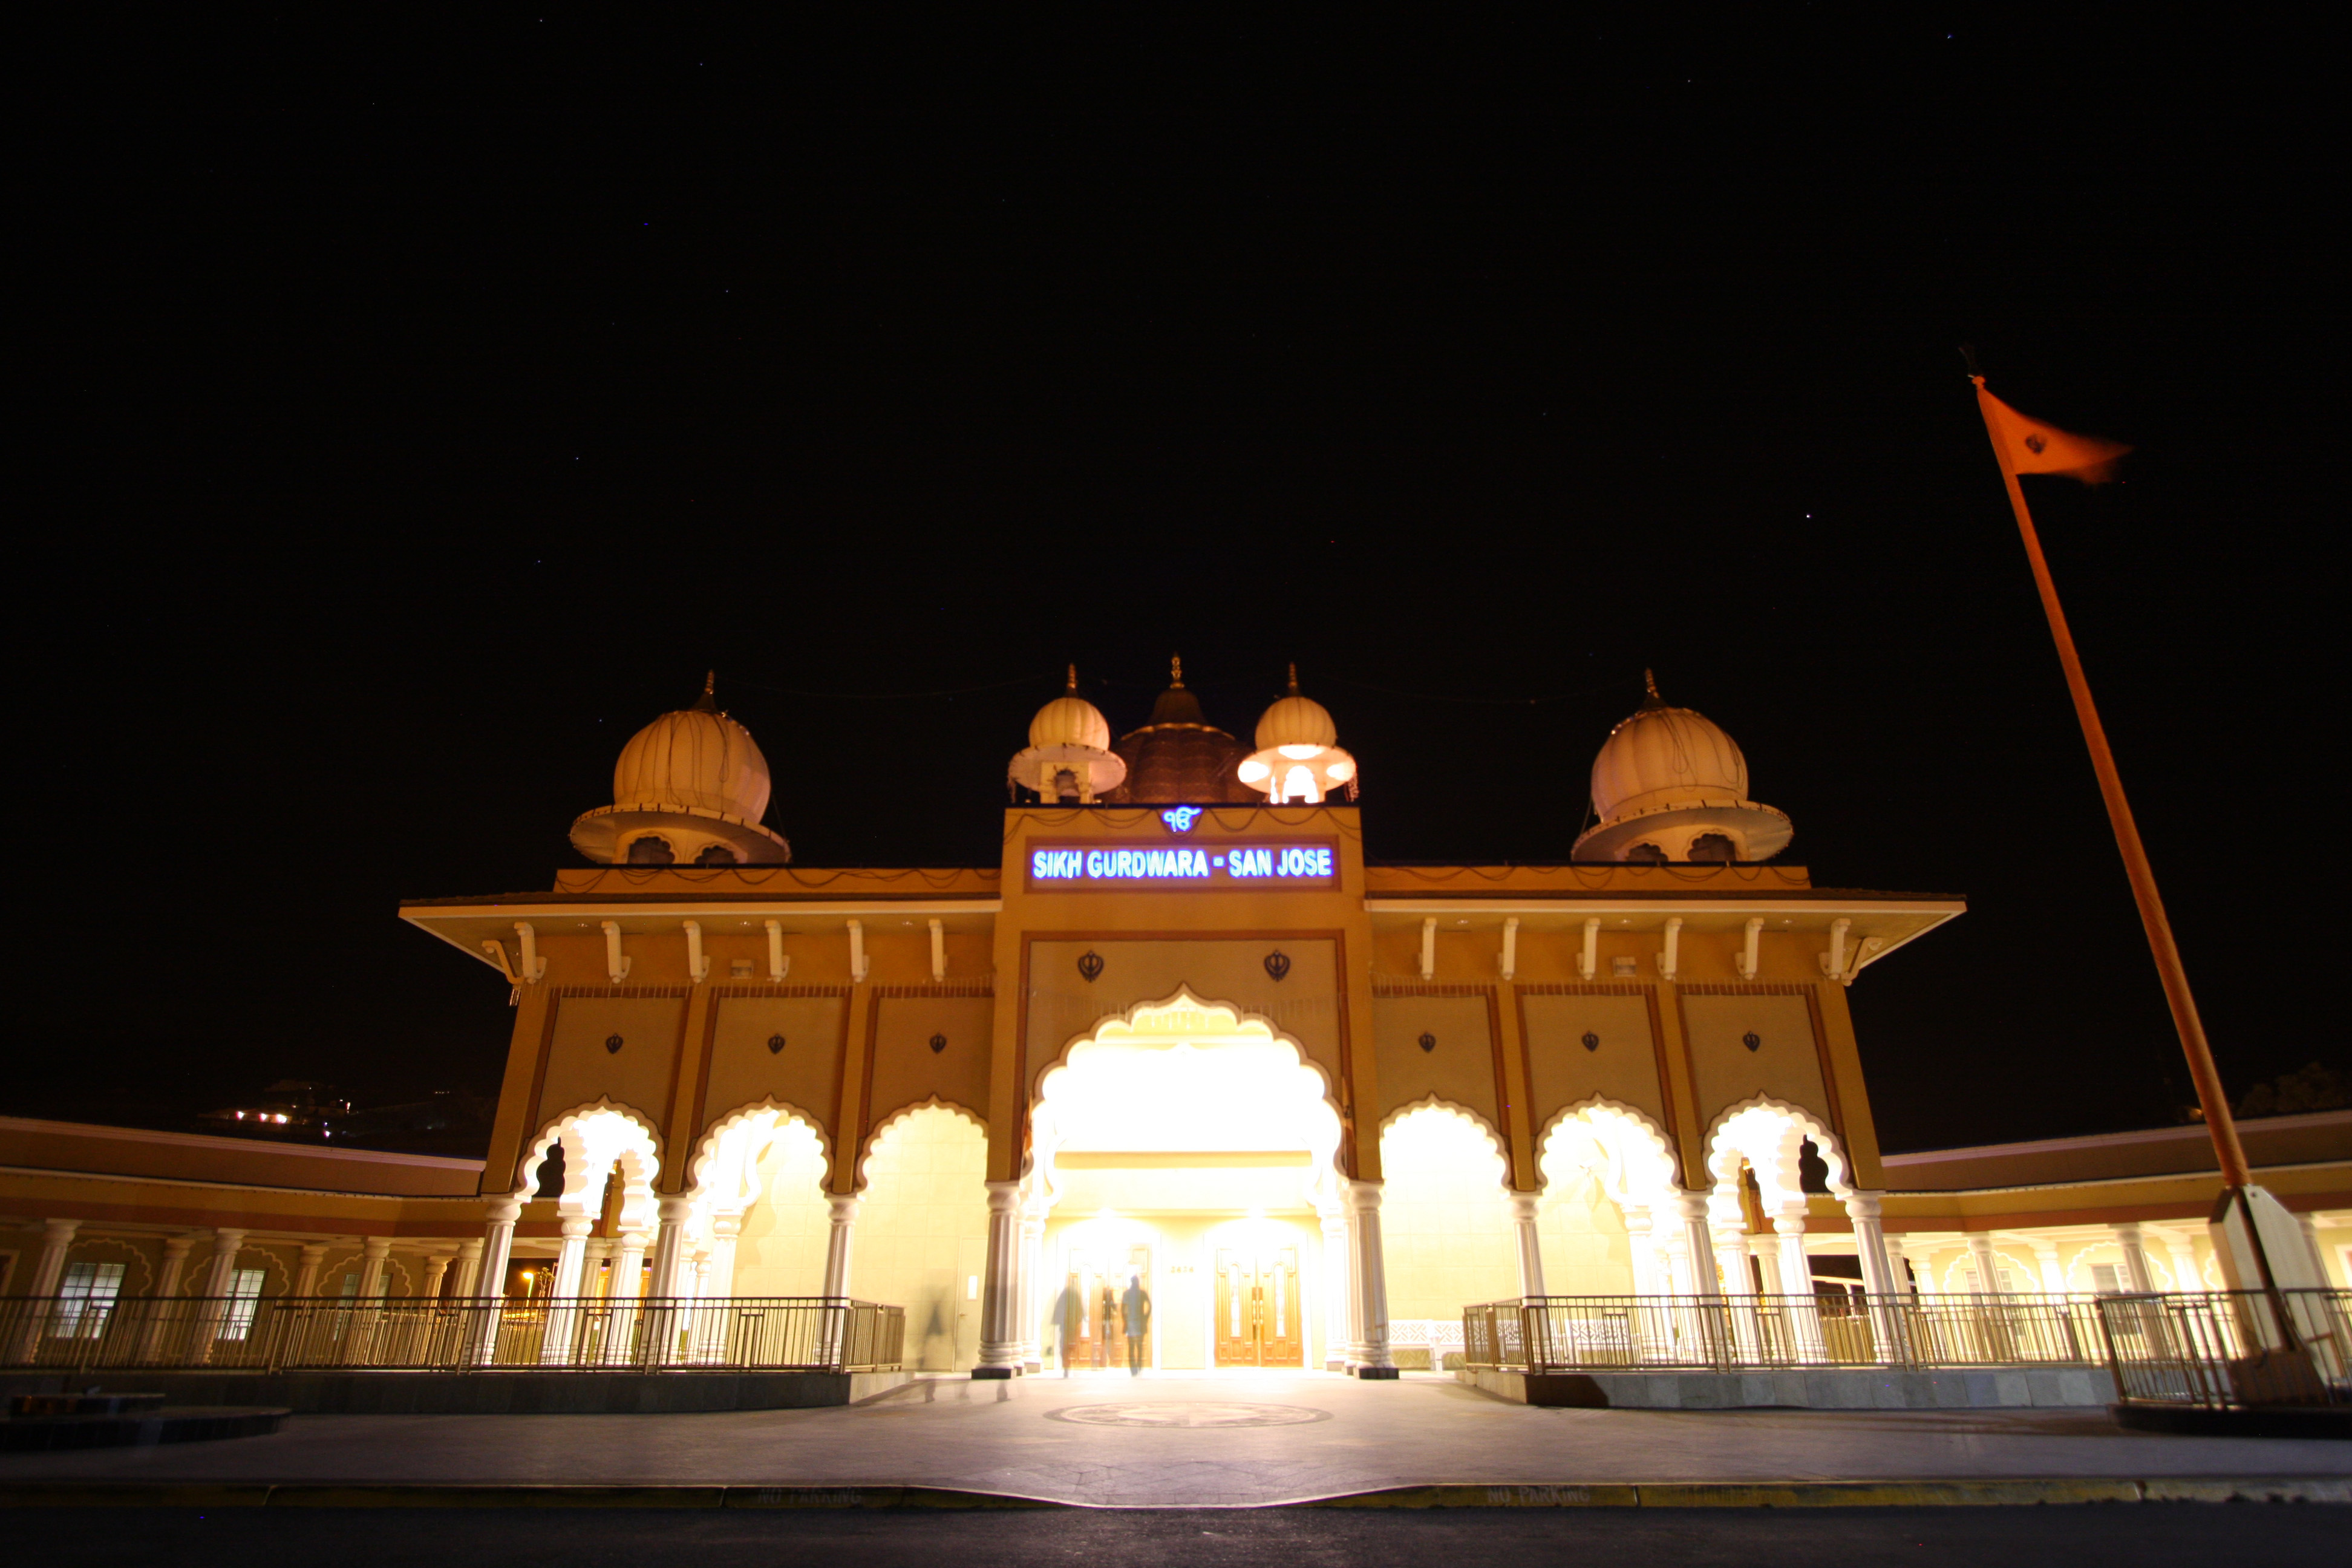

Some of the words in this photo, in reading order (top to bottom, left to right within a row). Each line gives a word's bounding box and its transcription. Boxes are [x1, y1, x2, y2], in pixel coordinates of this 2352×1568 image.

[1033, 851, 1082, 878] SIKH
[1088, 850, 1209, 878] GURDWARA
[1229, 849, 1272, 878] SAN
[1276, 849, 1331, 877] JOSE
[758, 1488, 781, 1504] NO
[789, 1488, 861, 1504] PARKING
[1488, 1486, 1511, 1503] NO
[1519, 1485, 1590, 1503] PARKING
